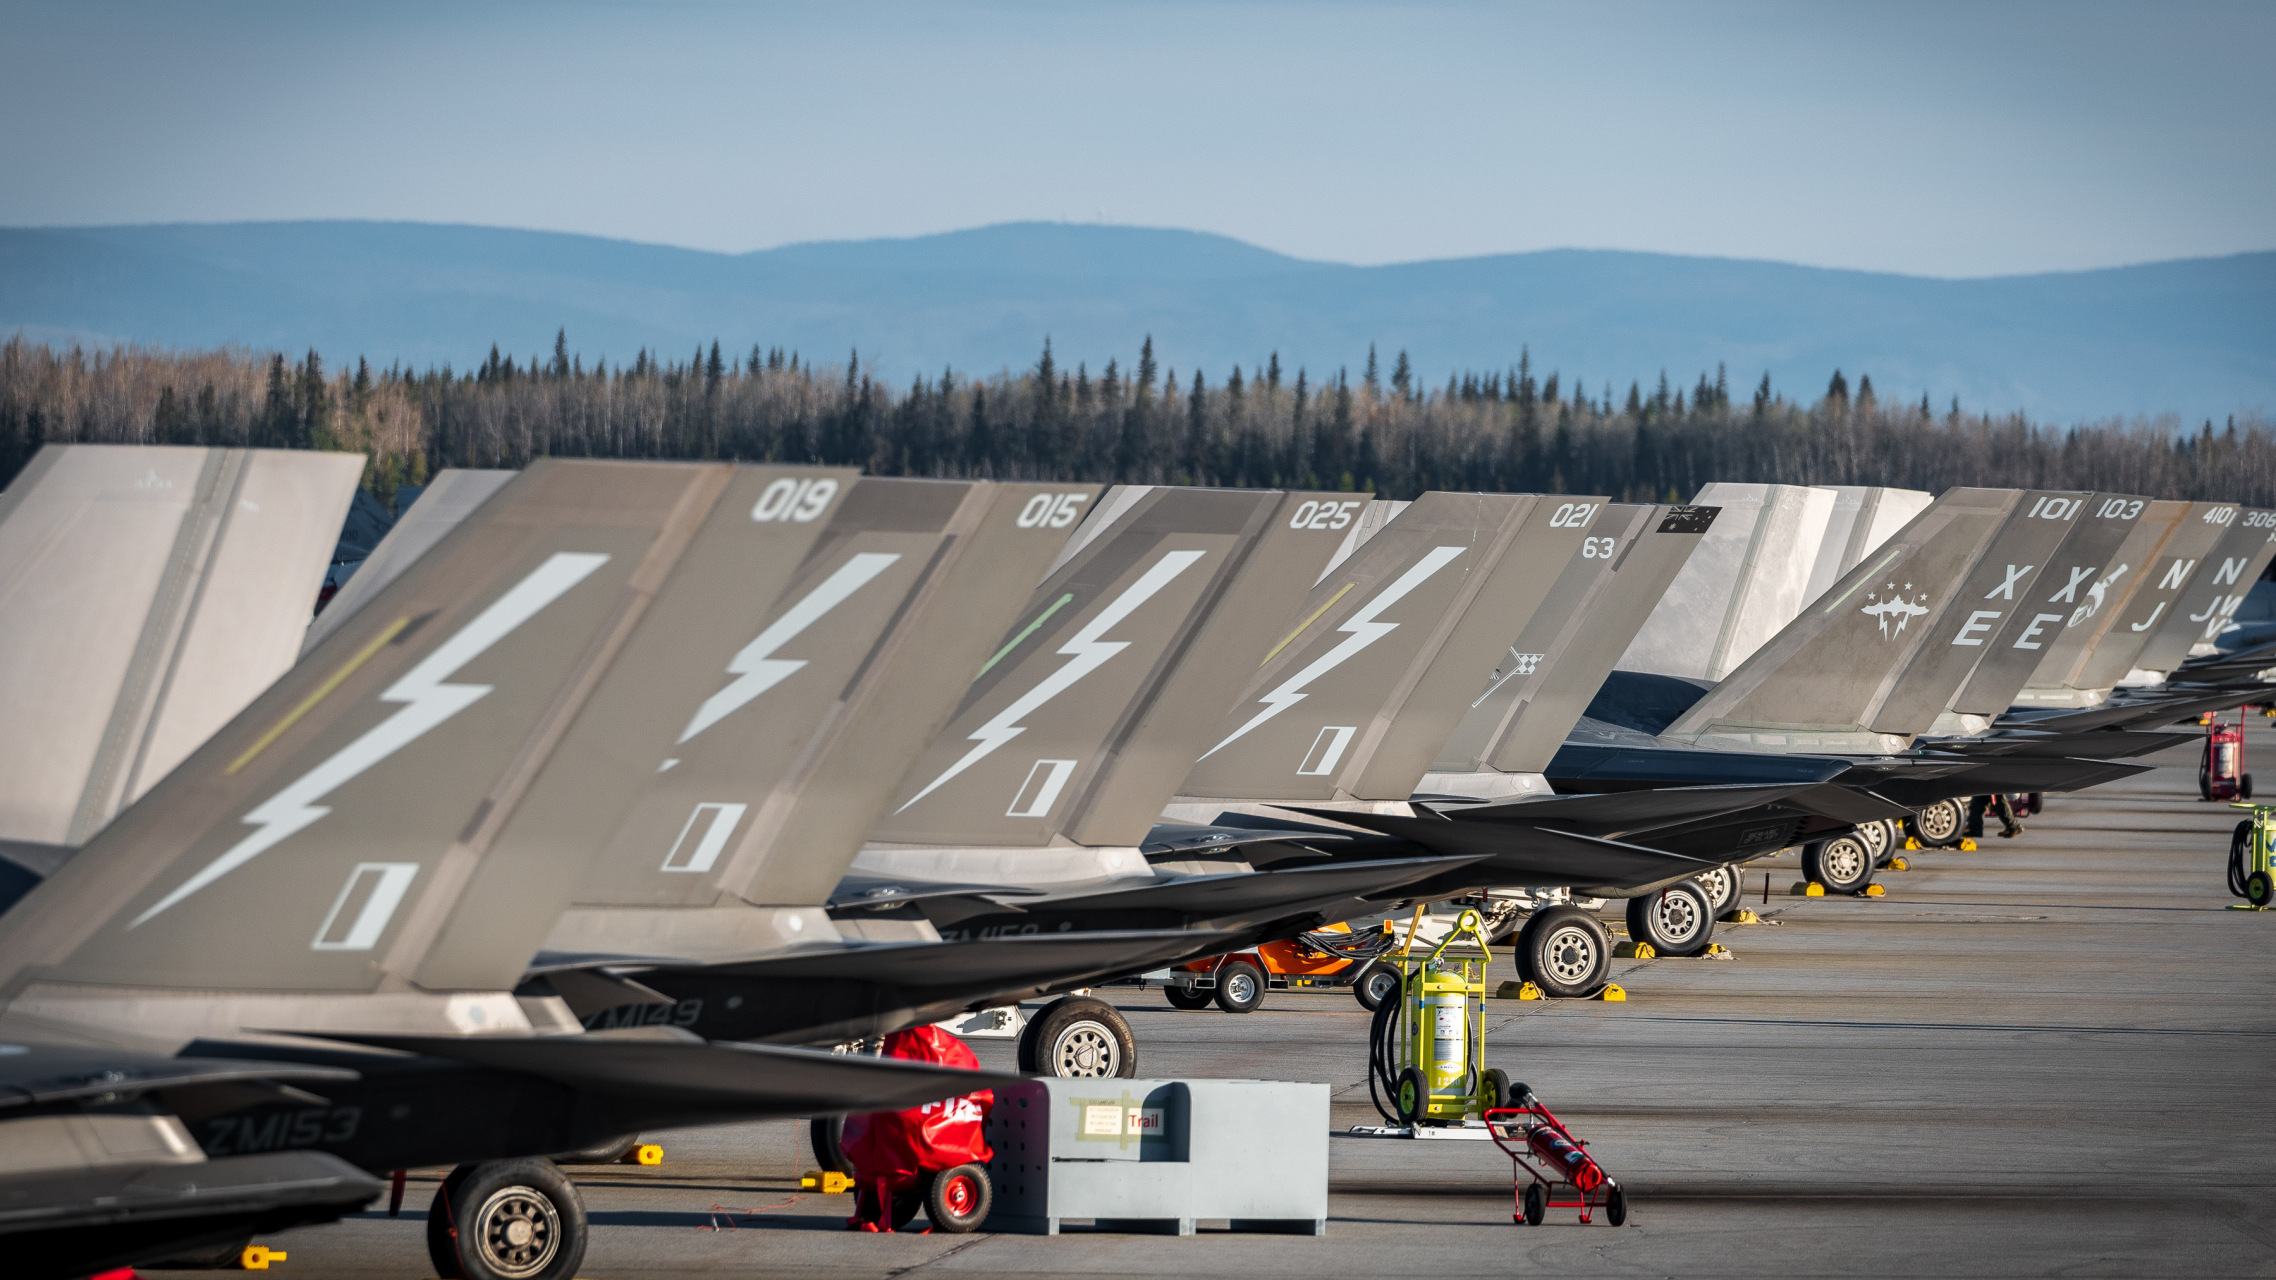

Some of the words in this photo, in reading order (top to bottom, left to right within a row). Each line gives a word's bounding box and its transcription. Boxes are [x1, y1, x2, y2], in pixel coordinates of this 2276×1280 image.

[752, 478, 839, 523] 019
[1016, 493, 1089, 528] 015
[2028, 496, 2083, 521] 101
[2096, 498, 2144, 520] 103
[1289, 501, 1361, 530] 025
[1550, 503, 1600, 528] 021
[1582, 537, 1615, 559] 63
[205, 1105, 363, 1156] ZM153
[1128, 1113, 1159, 1128] Trail
